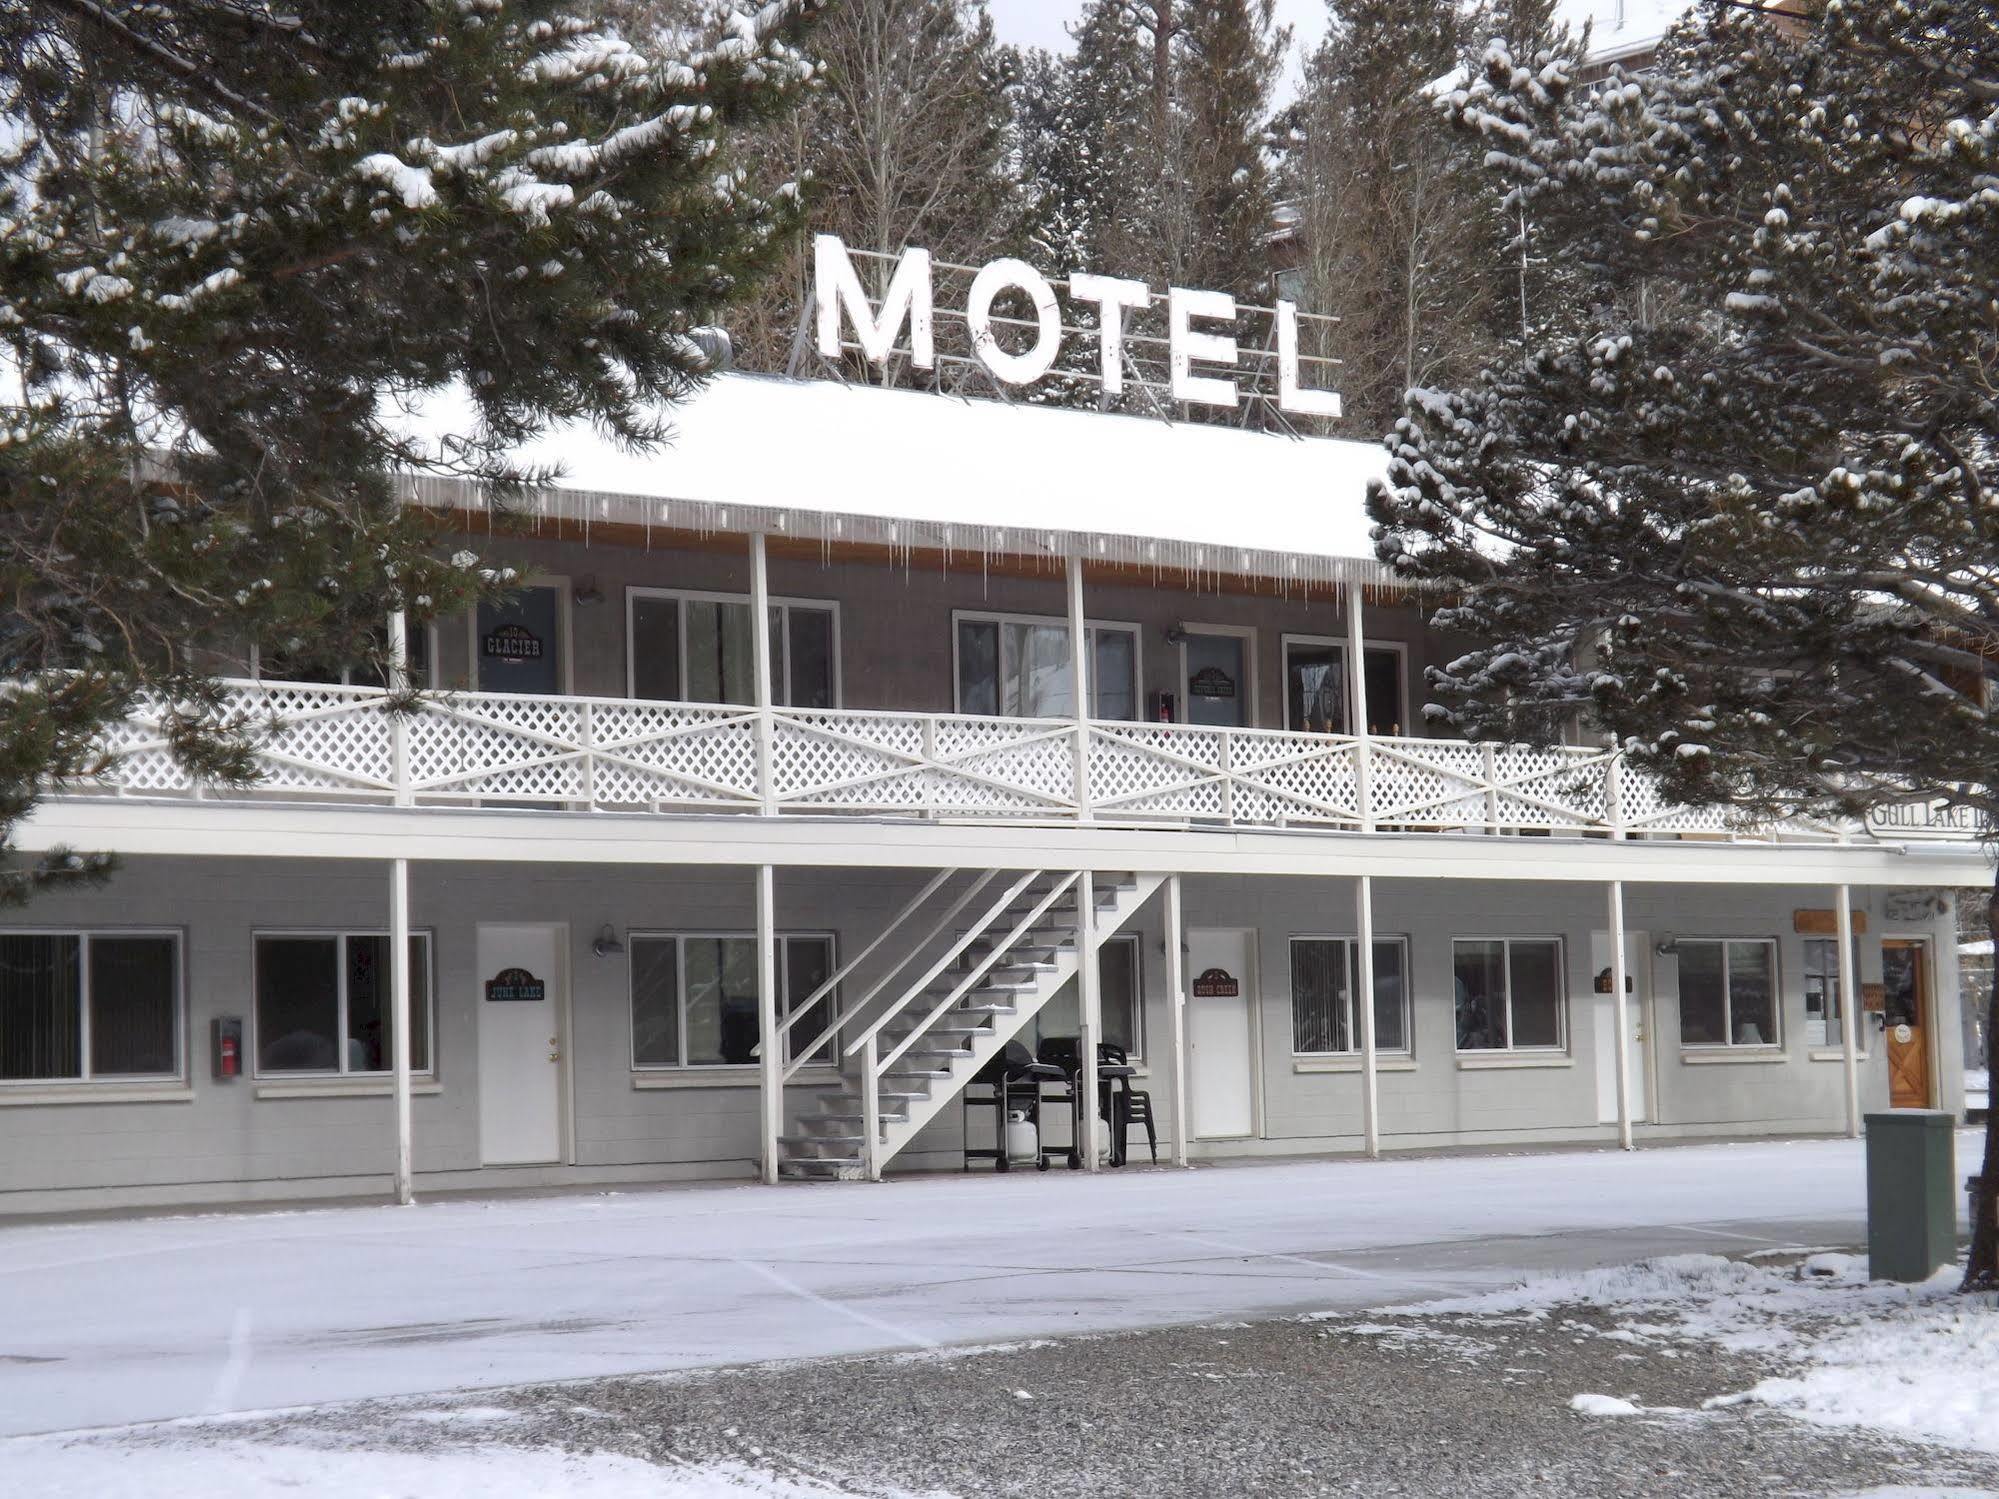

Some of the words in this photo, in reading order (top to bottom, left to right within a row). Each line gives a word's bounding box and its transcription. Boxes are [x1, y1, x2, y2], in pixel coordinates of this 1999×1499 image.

[815, 232, 1342, 417] MOTEL
[488, 637, 540, 656] GLACIER
[1872, 803, 1919, 826] GULL
[1923, 802, 1969, 827] LAKE
